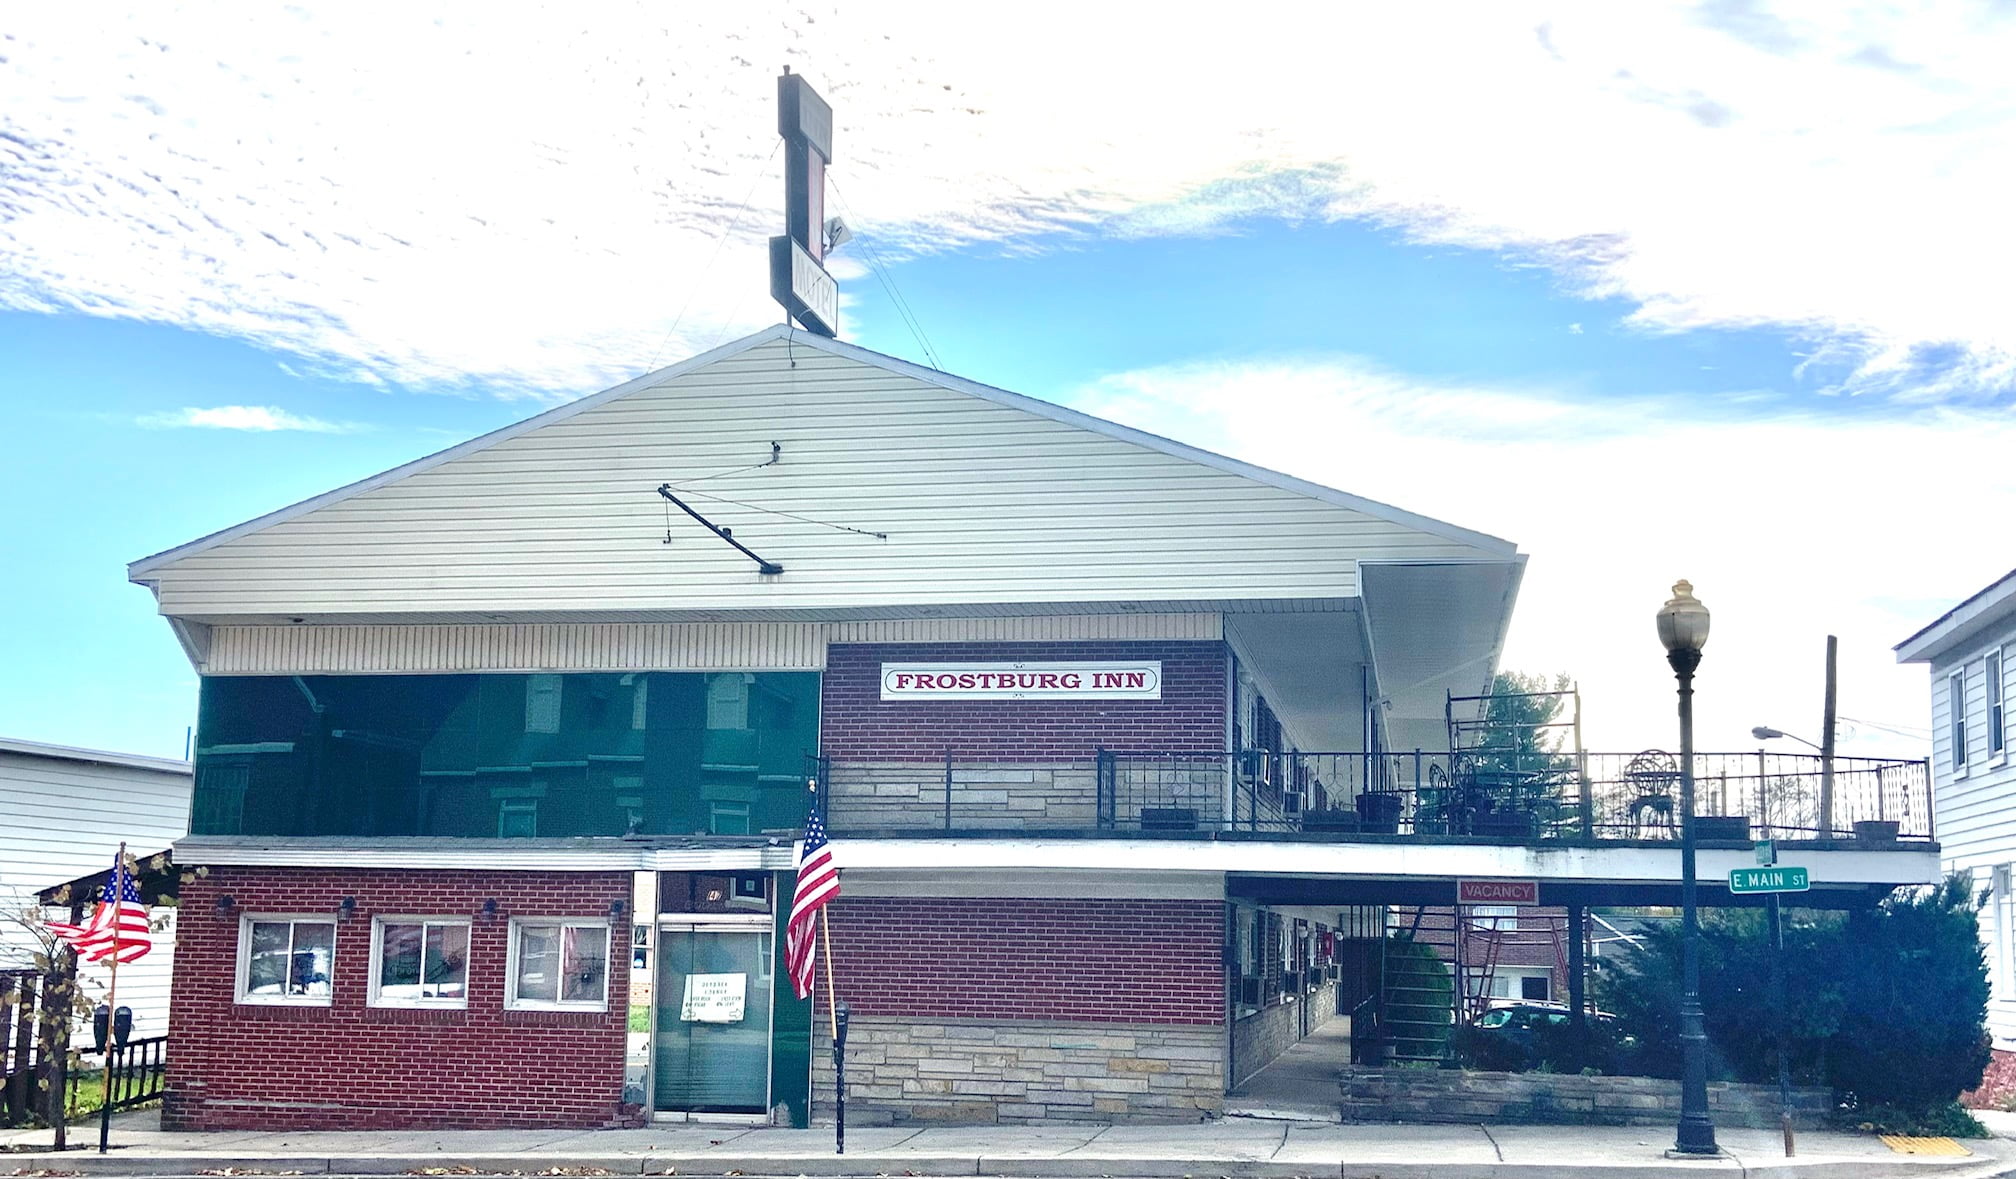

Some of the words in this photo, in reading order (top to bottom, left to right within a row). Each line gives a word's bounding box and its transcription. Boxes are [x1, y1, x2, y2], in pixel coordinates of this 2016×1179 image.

[895, 673, 1082, 689] FROSTBURG
[1092, 672, 1146, 688] INN
[1748, 872, 1784, 888] MAIN
[1792, 874, 1805, 886] ST
[1464, 883, 1532, 898] VACANCY
